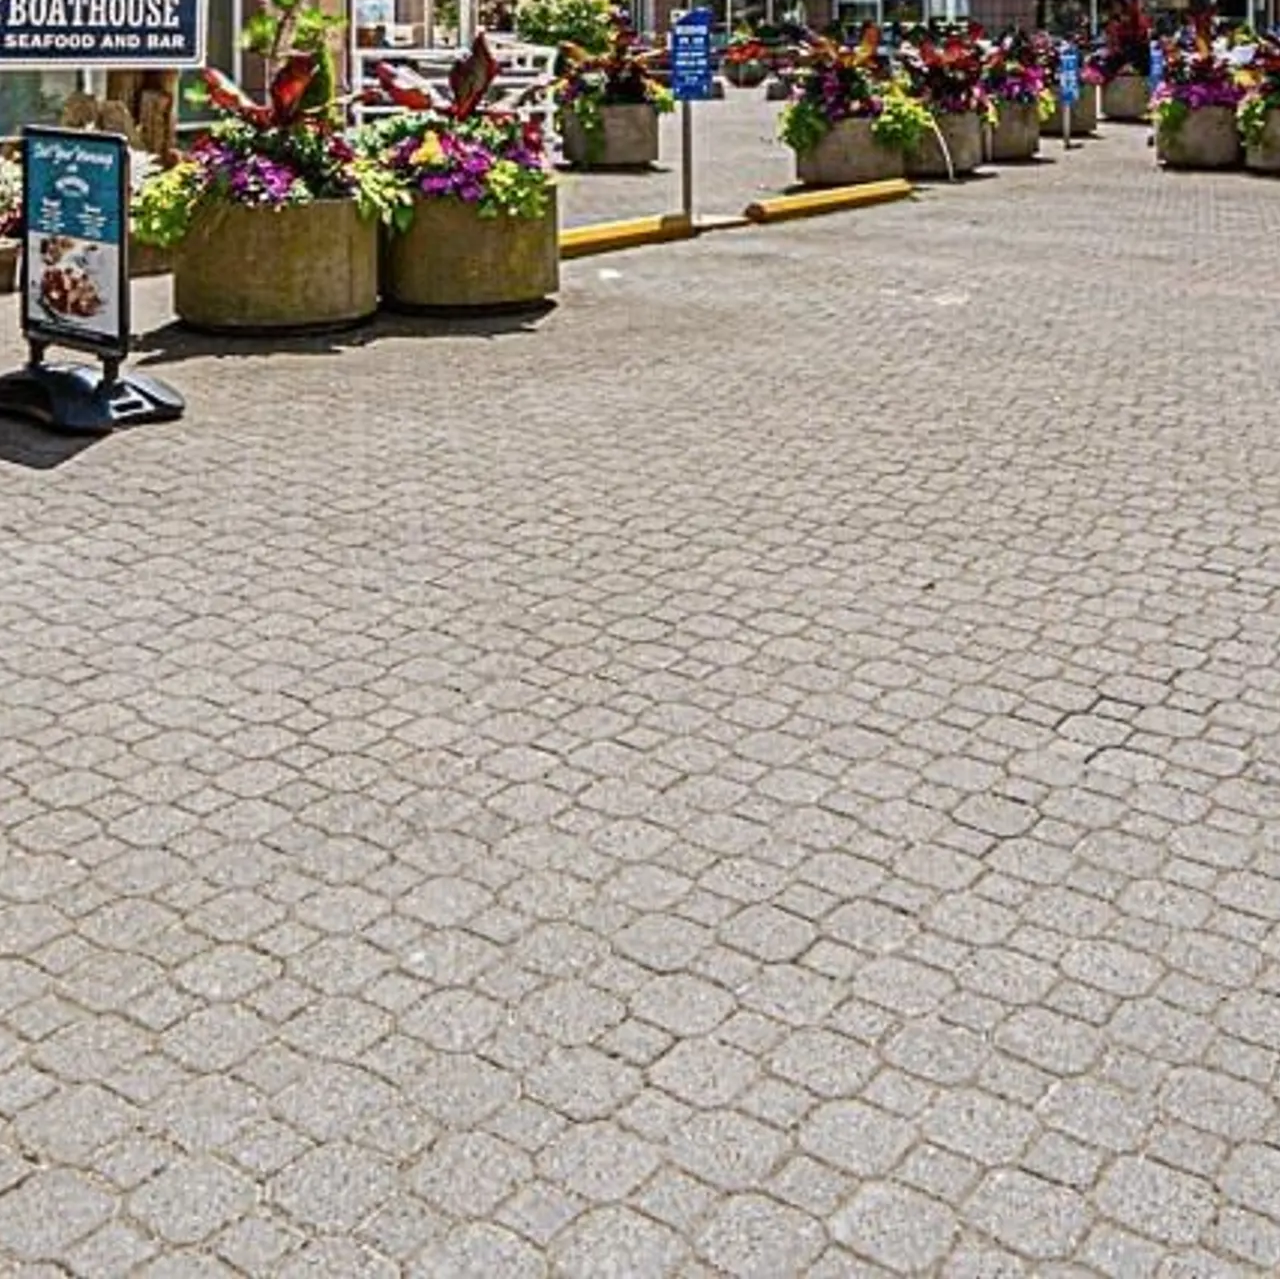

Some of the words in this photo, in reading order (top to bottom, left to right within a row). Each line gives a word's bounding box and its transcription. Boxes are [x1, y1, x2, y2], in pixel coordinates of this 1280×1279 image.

[5, 34, 95, 48] SEAFOOD
[100, 35, 140, 48] AND
[147, 36, 185, 49] BAR
